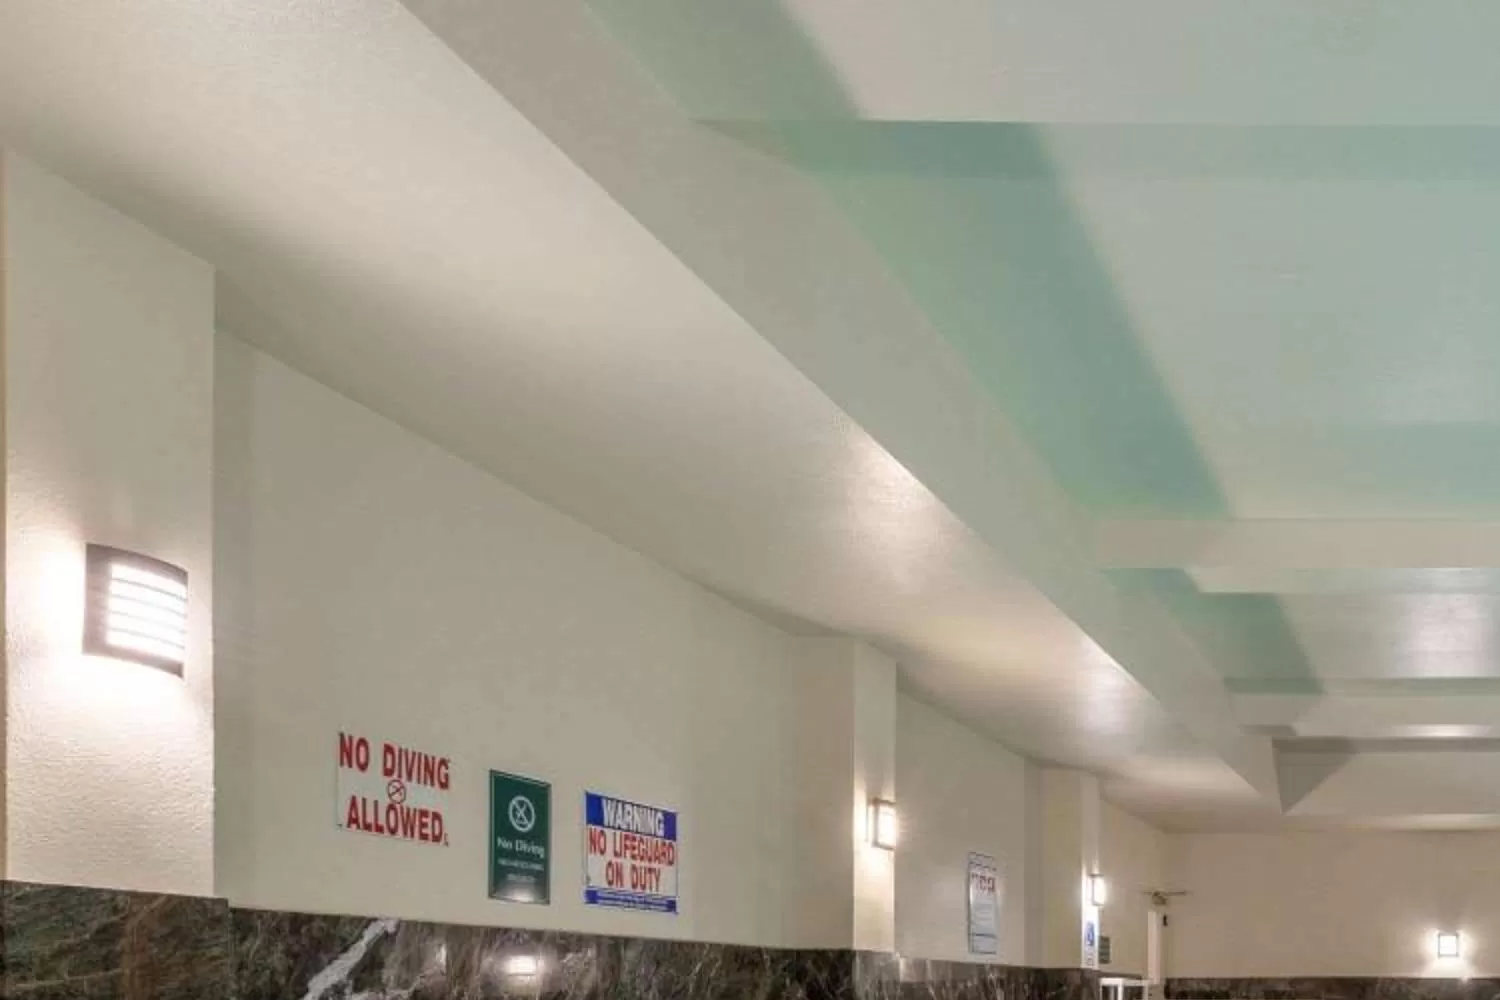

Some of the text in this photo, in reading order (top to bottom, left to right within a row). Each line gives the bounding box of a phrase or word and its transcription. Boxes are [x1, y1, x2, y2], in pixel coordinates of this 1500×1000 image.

[339, 731, 449, 790] NO DIVING
[346, 795, 444, 843] ALLOWED
[601, 797, 665, 838] WARNING
[497, 836, 545, 859] No Diving
[588, 827, 607, 856] NO
[606, 860, 662, 893] ON DUTY
